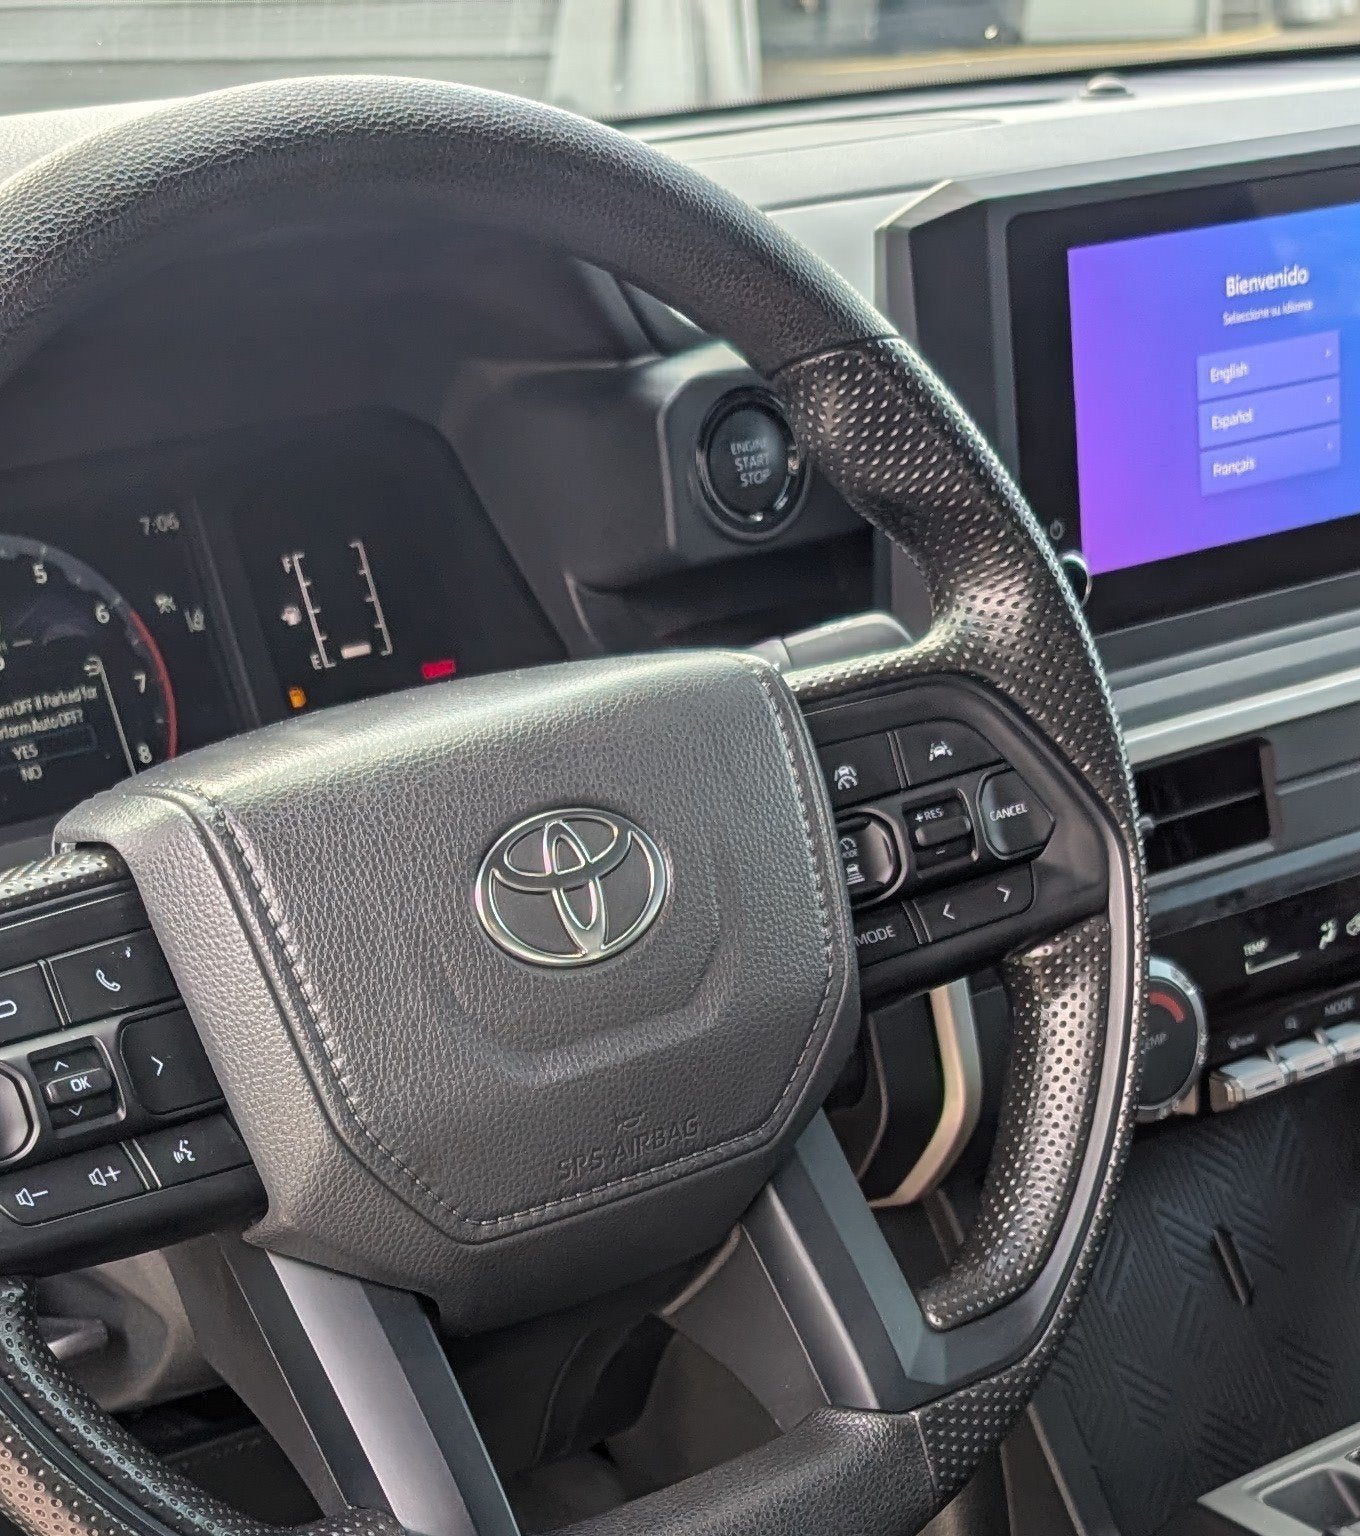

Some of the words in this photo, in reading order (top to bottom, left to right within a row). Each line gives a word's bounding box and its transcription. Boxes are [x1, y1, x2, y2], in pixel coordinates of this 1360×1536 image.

[1225, 264, 1310, 298] Bienvenido
[1210, 362, 1249, 384] English
[1211, 408, 1254, 430] Español
[730, 438, 767, 455] ENGINE
[734, 452, 770, 472] START
[1213, 457, 1256, 478] Français
[739, 468, 772, 488] STOP
[32, 563, 48, 584] 5
[94, 604, 111, 625] 6
[133, 671, 147, 694] 7
[13, 698, 33, 716] OFF
[42, 688, 82, 708] Parked
[80, 685, 98, 701] for
[11, 743, 40, 761] YES
[138, 742, 154, 764] 8
[19, 764, 43, 783] NO
[990, 803, 1028, 822] CANCEL
[853, 926, 897, 947] MODE
[1243, 939, 1269, 957] TEMP
[1324, 996, 1356, 1016] MODE
[70, 1076, 92, 1093] OK
[614, 1115, 701, 1164] AIRBAG
